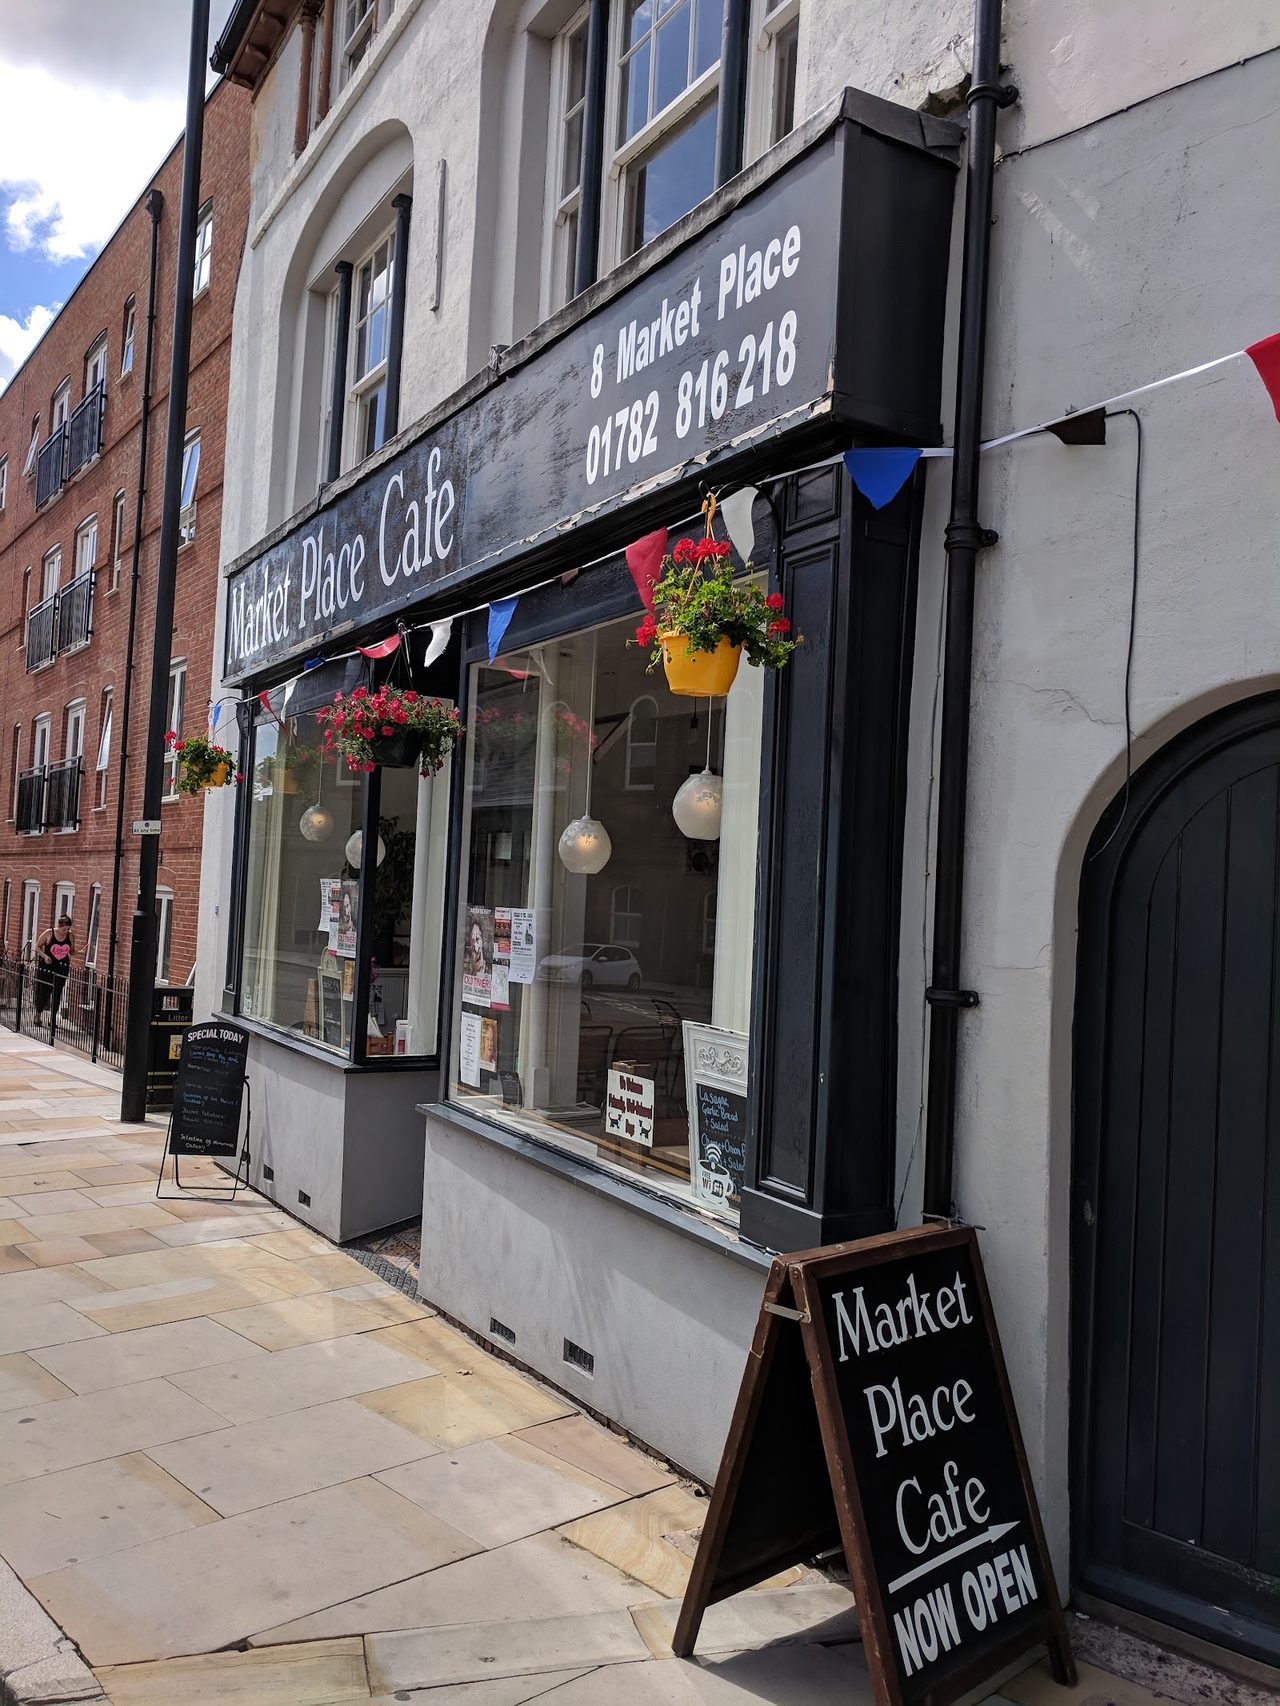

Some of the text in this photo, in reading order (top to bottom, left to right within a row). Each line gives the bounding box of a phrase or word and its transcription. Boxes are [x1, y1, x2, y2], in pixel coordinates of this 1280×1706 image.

[590, 224, 801, 399] 8 Market Place
[585, 310, 798, 486] 01782 816 218
[227, 446, 455, 667] Market Place Cafe
[187, 1028, 244, 1044] SPECIAL TODAY
[710, 1117, 729, 1132] Salad
[831, 1271, 973, 1363] Market
[862, 1377, 976, 1458] Place
[895, 1459, 990, 1555] Cafe
[893, 1543, 1038, 1677] NOW OPEN
